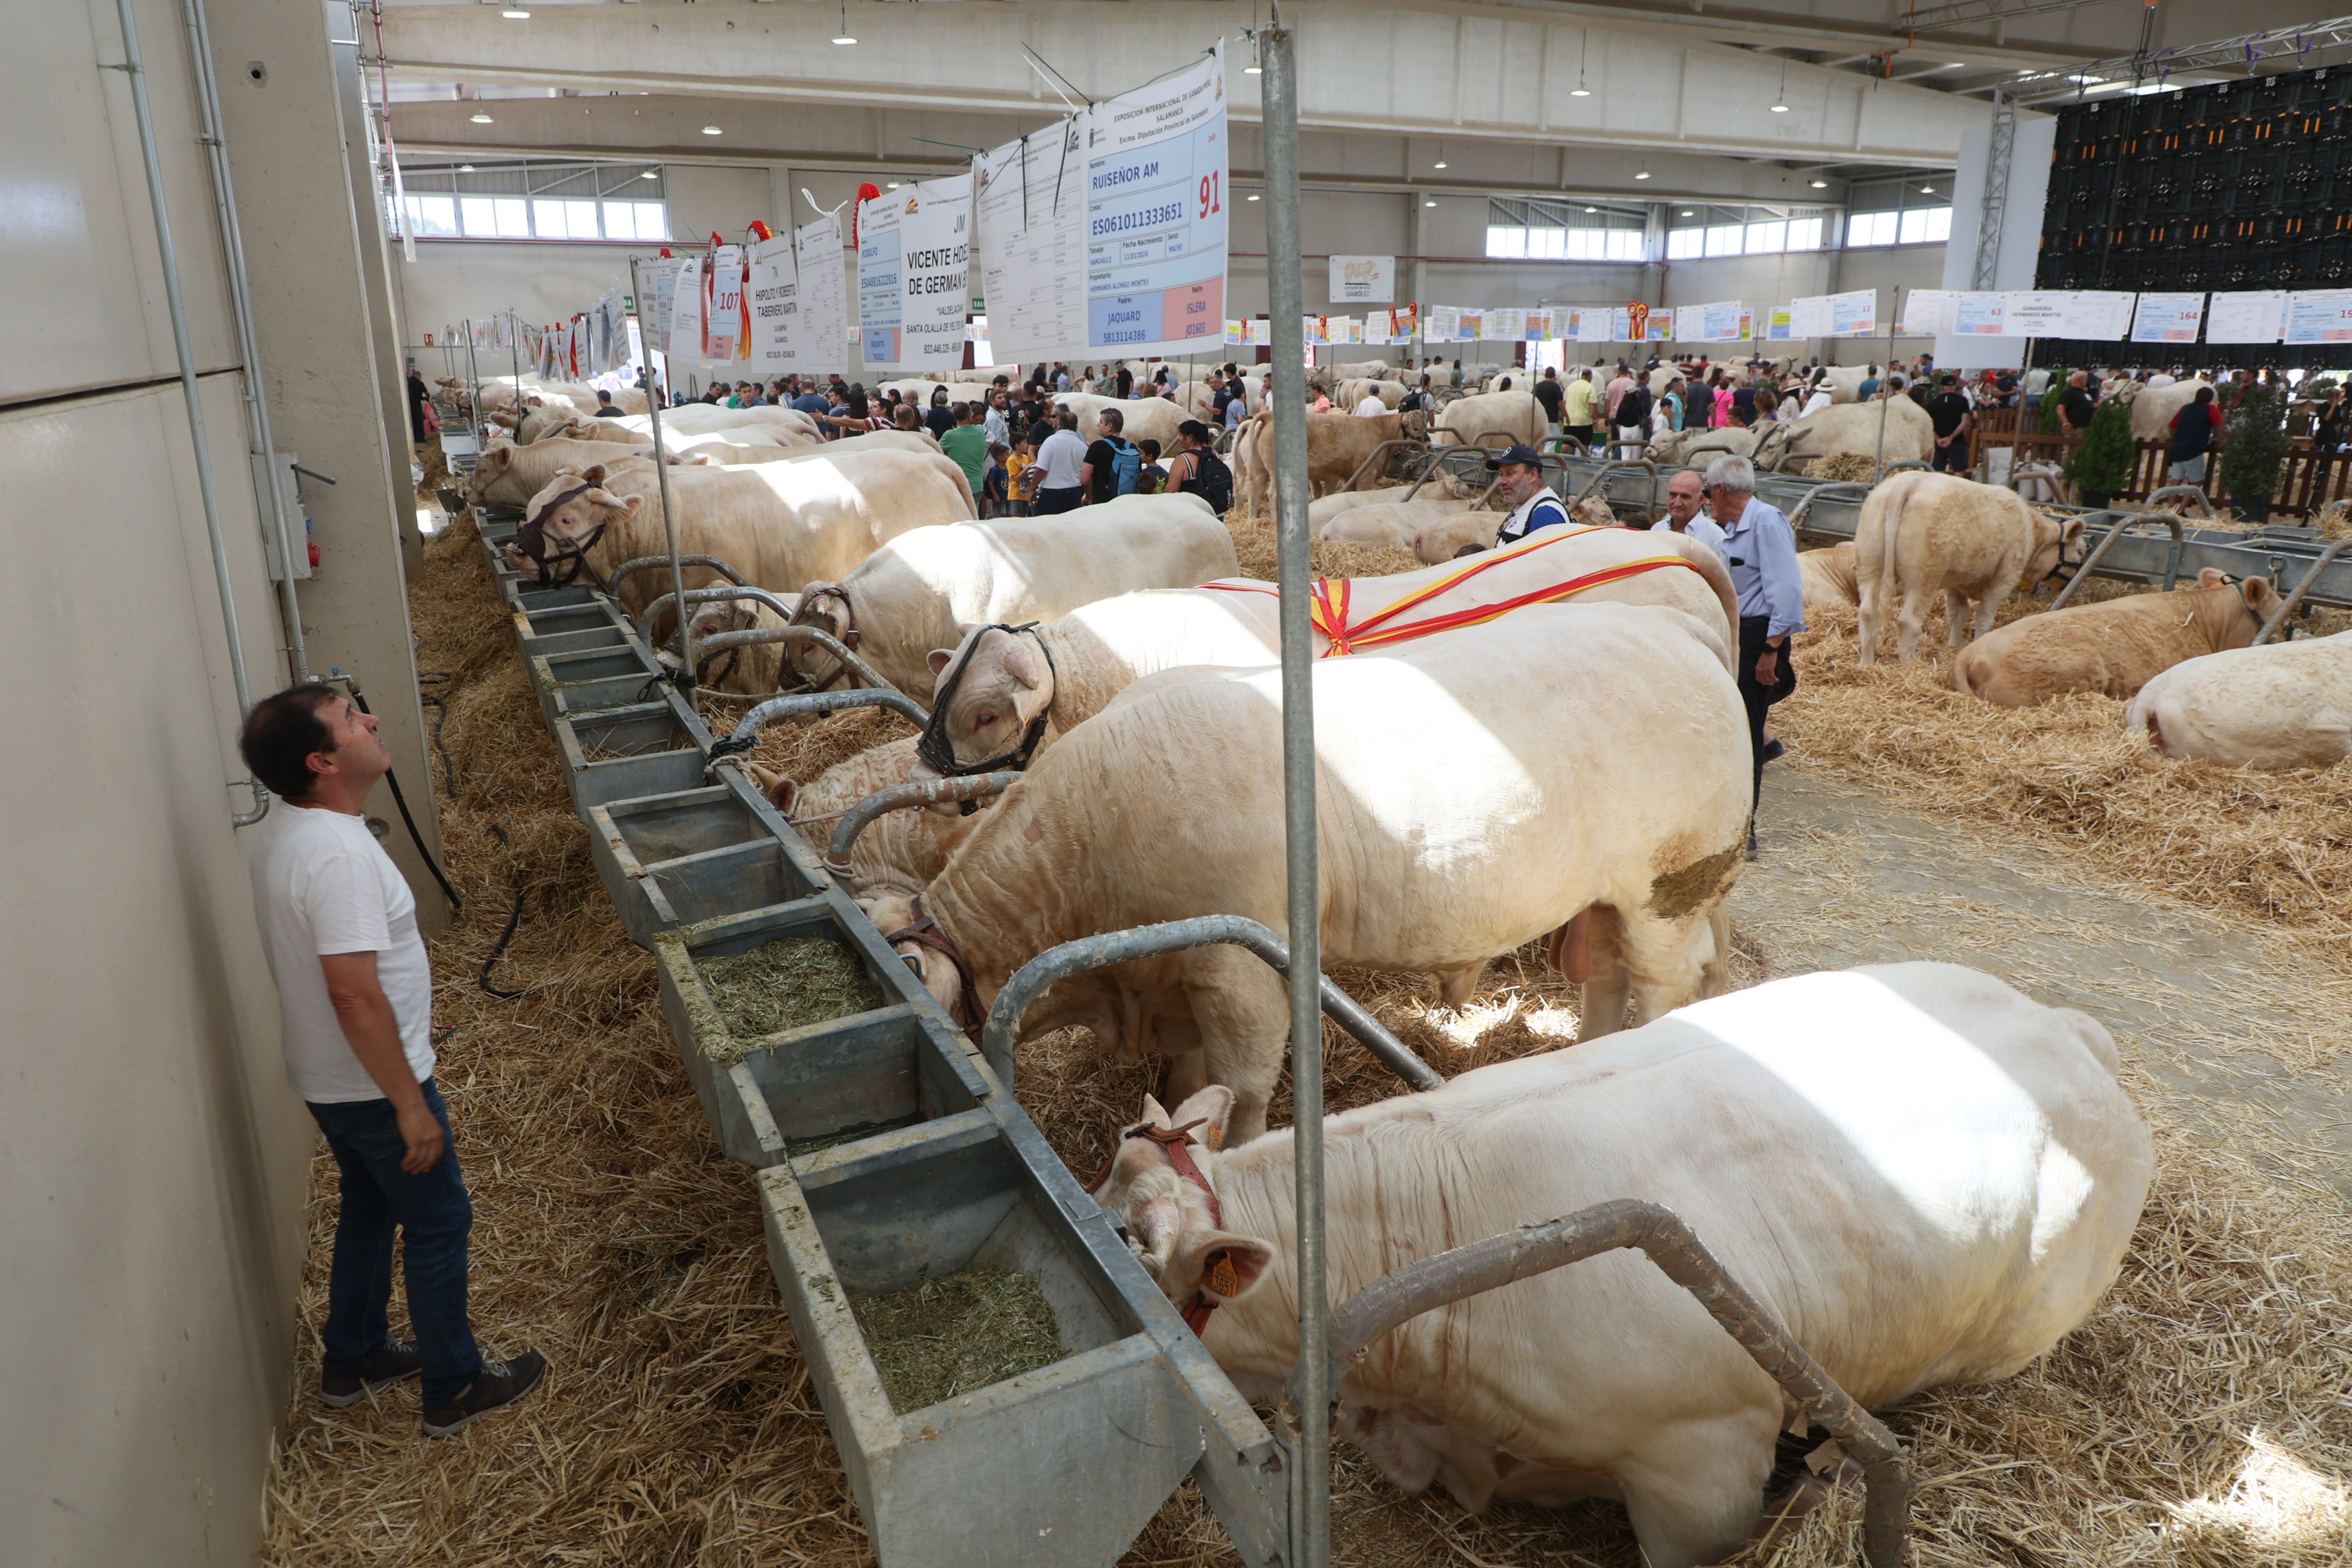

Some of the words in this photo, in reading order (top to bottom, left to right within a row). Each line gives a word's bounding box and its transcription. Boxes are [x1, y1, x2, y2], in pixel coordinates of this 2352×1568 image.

[1114, 107, 1144, 123] EXPOSICION
[1144, 96, 1181, 114] INTERNACIONAL
[1182, 92, 1188, 102] DE
[1156, 108, 1184, 122] SALAMANCA
[1119, 134, 1137, 144] Excma.
[1138, 126, 1163, 140] Diputación
[1164, 119, 1185, 133] Provincial
[1186, 115, 1190, 124] de
[1090, 160, 1106, 169] Nombre:
[1093, 166, 1140, 190] RUISEÑOR
[1143, 161, 1159, 179] AM
[1199, 170, 1220, 219] 91
[1089, 204, 1102, 212] Crotal:
[954, 213, 966, 233] JM
[1093, 202, 1182, 236] ES061011333651
[1137, 236, 1164, 247] Nacimiento:
[1168, 233, 1179, 241] Sexo:
[1168, 243, 1183, 253] MACHO
[907, 248, 951, 269] VICENTE
[909, 277, 923, 295] DE
[925, 273, 962, 294] GERMAN
[1112, 280, 1130, 290] ALONSO
[1131, 279, 1149, 288] MONTES
[720, 291, 740, 310] 107
[756, 288, 776, 302] HIPOLITO
[779, 284, 796, 299] ROBERTO
[1117, 297, 1132, 305] Padre:
[1186, 300, 1206, 315] ISLERA
[758, 304, 783, 318] TABERNERO
[1108, 310, 1141, 326] JAQUARD
[906, 324, 923, 333] SANTA
[924, 324, 942, 333] OLALLA
[943, 322, 949, 331] DE
[1103, 329, 1146, 344] 5813114386
[1214, 1274, 1233, 1298] 3651
